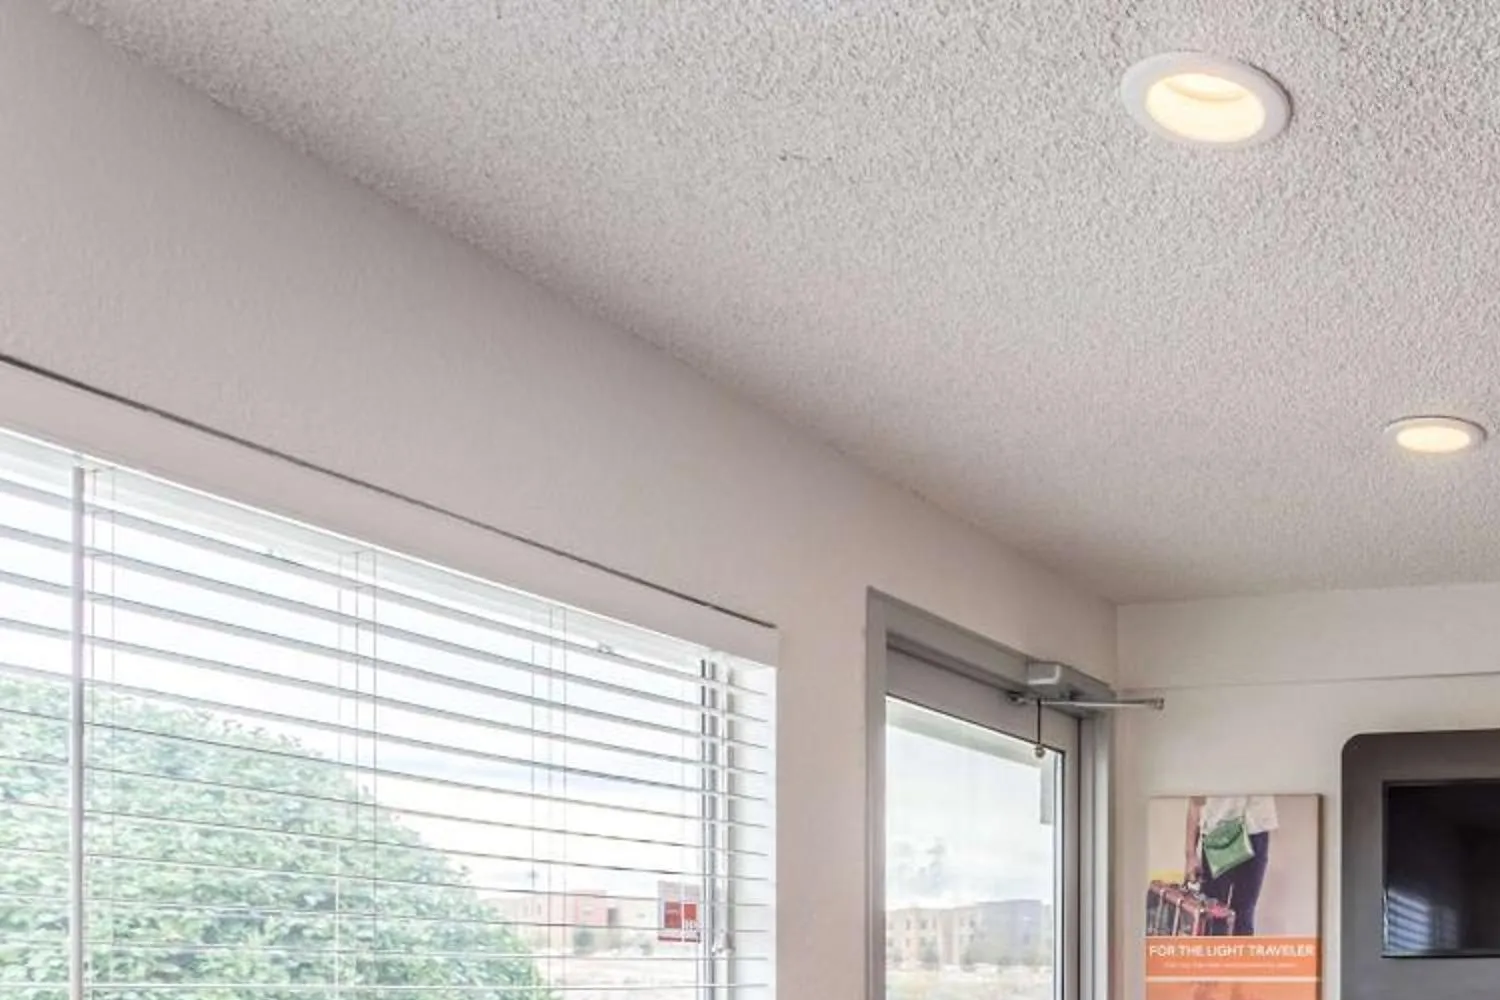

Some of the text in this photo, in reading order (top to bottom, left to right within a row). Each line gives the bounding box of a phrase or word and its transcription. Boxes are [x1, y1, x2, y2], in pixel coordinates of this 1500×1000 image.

[1149, 944, 1315, 957] FOR THE LIGHT TRAVELER
